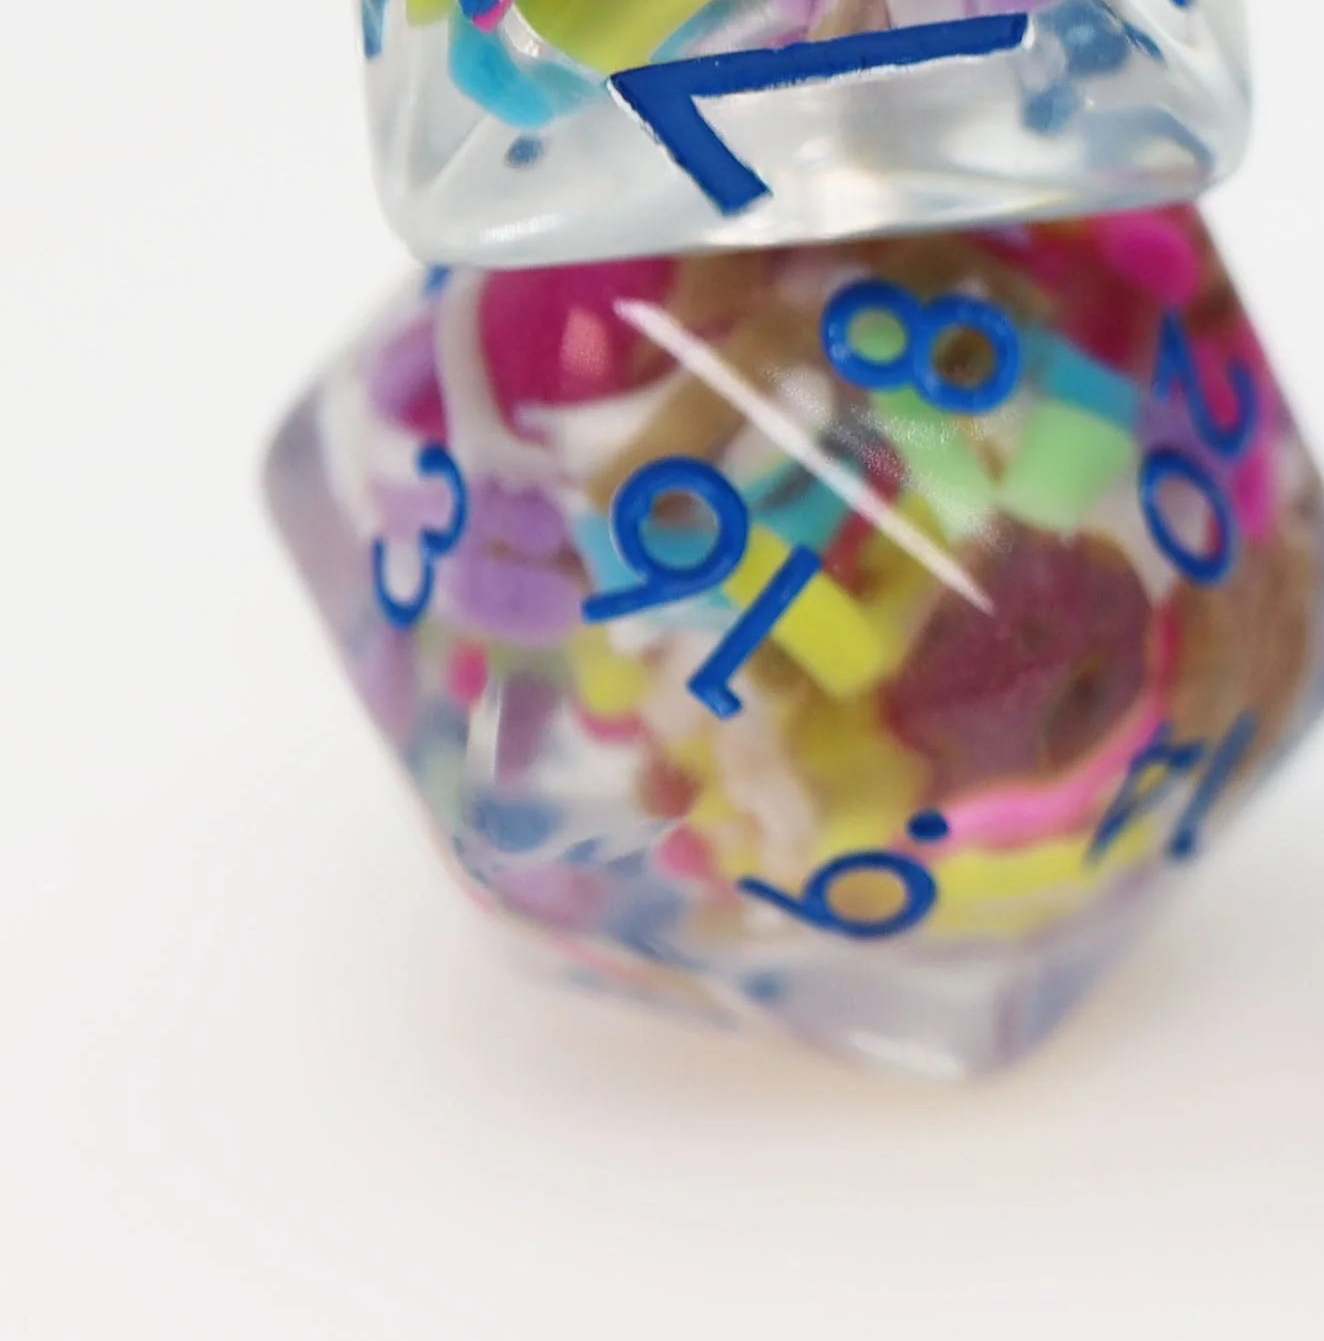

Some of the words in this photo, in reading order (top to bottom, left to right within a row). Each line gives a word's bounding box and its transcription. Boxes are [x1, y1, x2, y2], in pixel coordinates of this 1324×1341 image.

[822, 278, 1024, 414] 8
[372, 442, 470, 631] 3
[1138, 307, 1262, 585] 20
